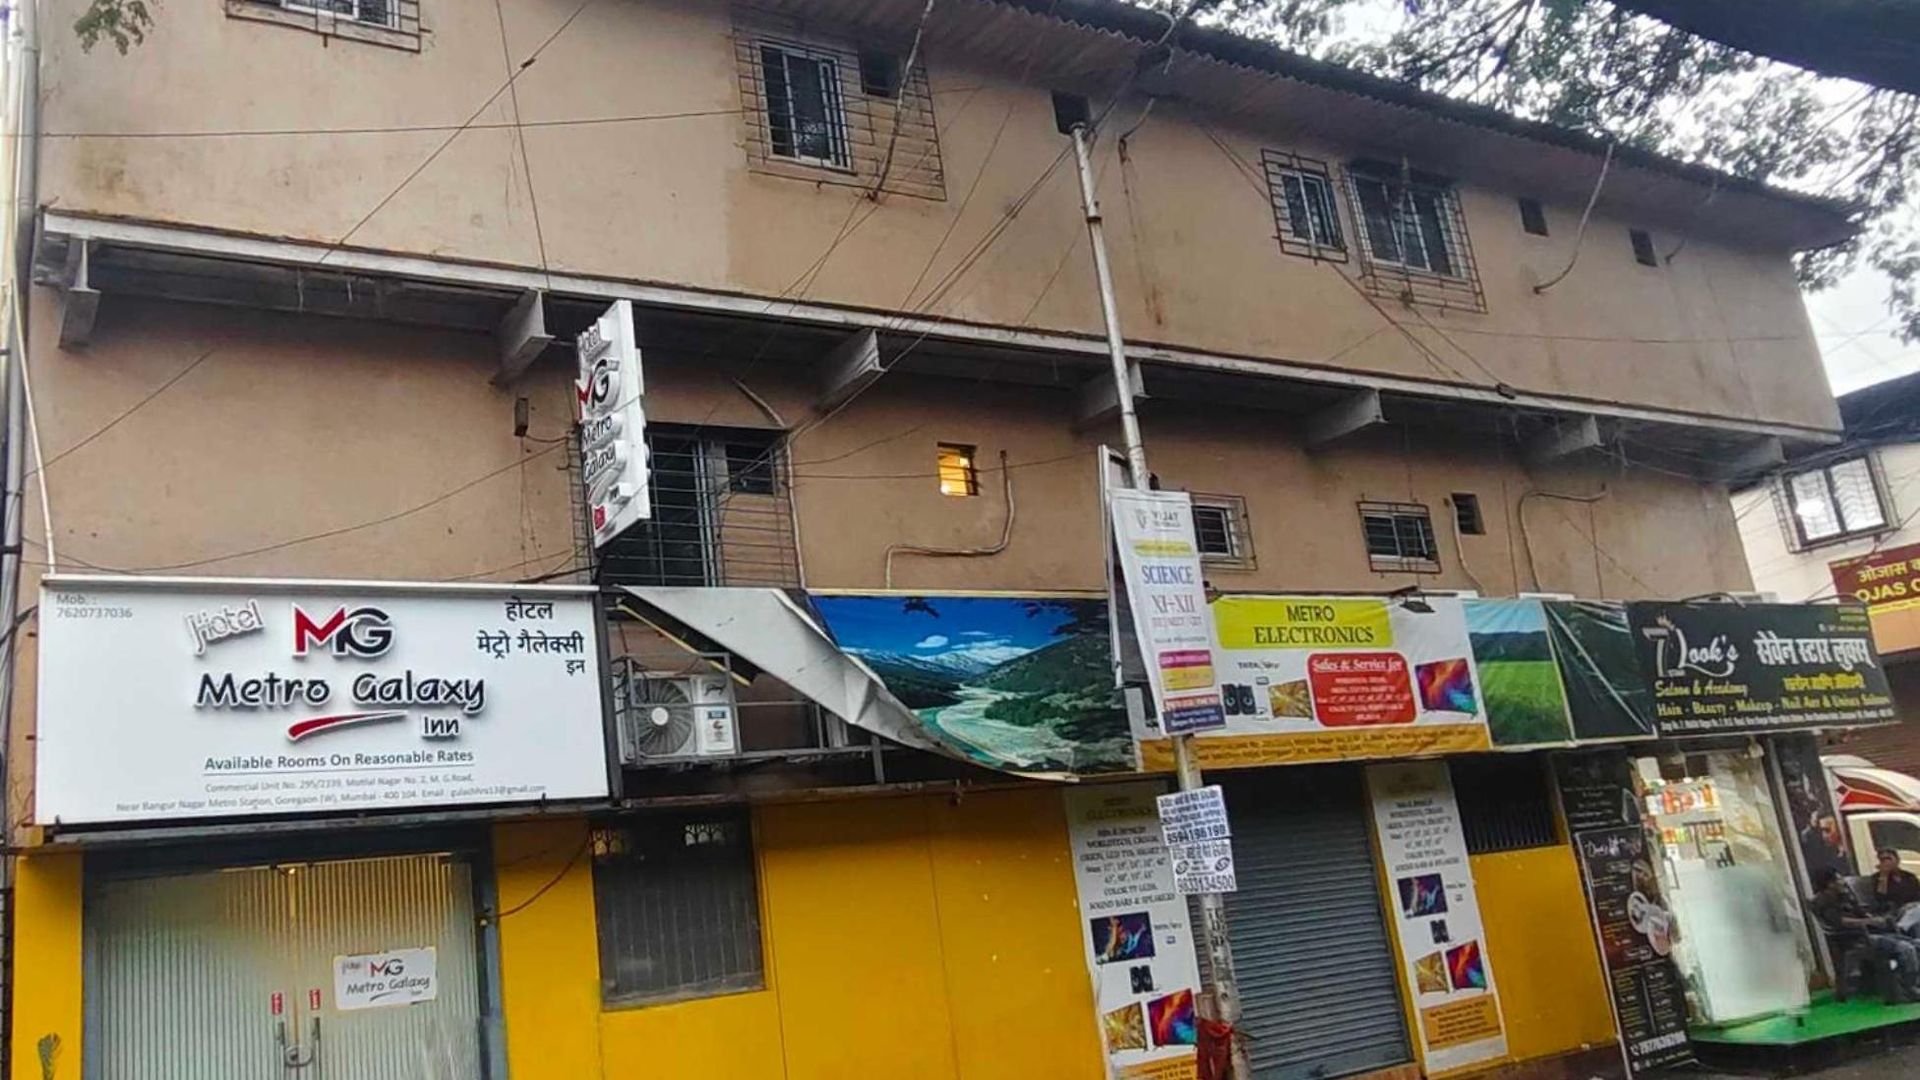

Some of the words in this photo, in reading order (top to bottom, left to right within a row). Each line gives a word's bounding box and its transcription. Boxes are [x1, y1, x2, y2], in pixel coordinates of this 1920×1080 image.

[1142, 565, 1195, 584] SCIENCE
[1856, 582, 1907, 602] OJAS
[504, 596, 554, 621] होटल
[1286, 605, 1335, 622] METRO
[293, 606, 393, 655] MG
[1254, 626, 1374, 644] ELECTRONICS
[476, 630, 511, 659] मेट्रो
[517, 628, 584, 654] गैलेक्सी
[565, 660, 585, 676] इन
[198, 672, 330, 705] Metro
[352, 670, 485, 711] Galaxy
[423, 716, 460, 735] Inn
[205, 757, 273, 770] Available
[277, 755, 326, 768] Rooms
[330, 754, 351, 766] On
[355, 752, 434, 766] Reasonable
[437, 750, 474, 762] Rates
[346, 982, 385, 996] Metro
[389, 976, 430, 990] Galaxy
